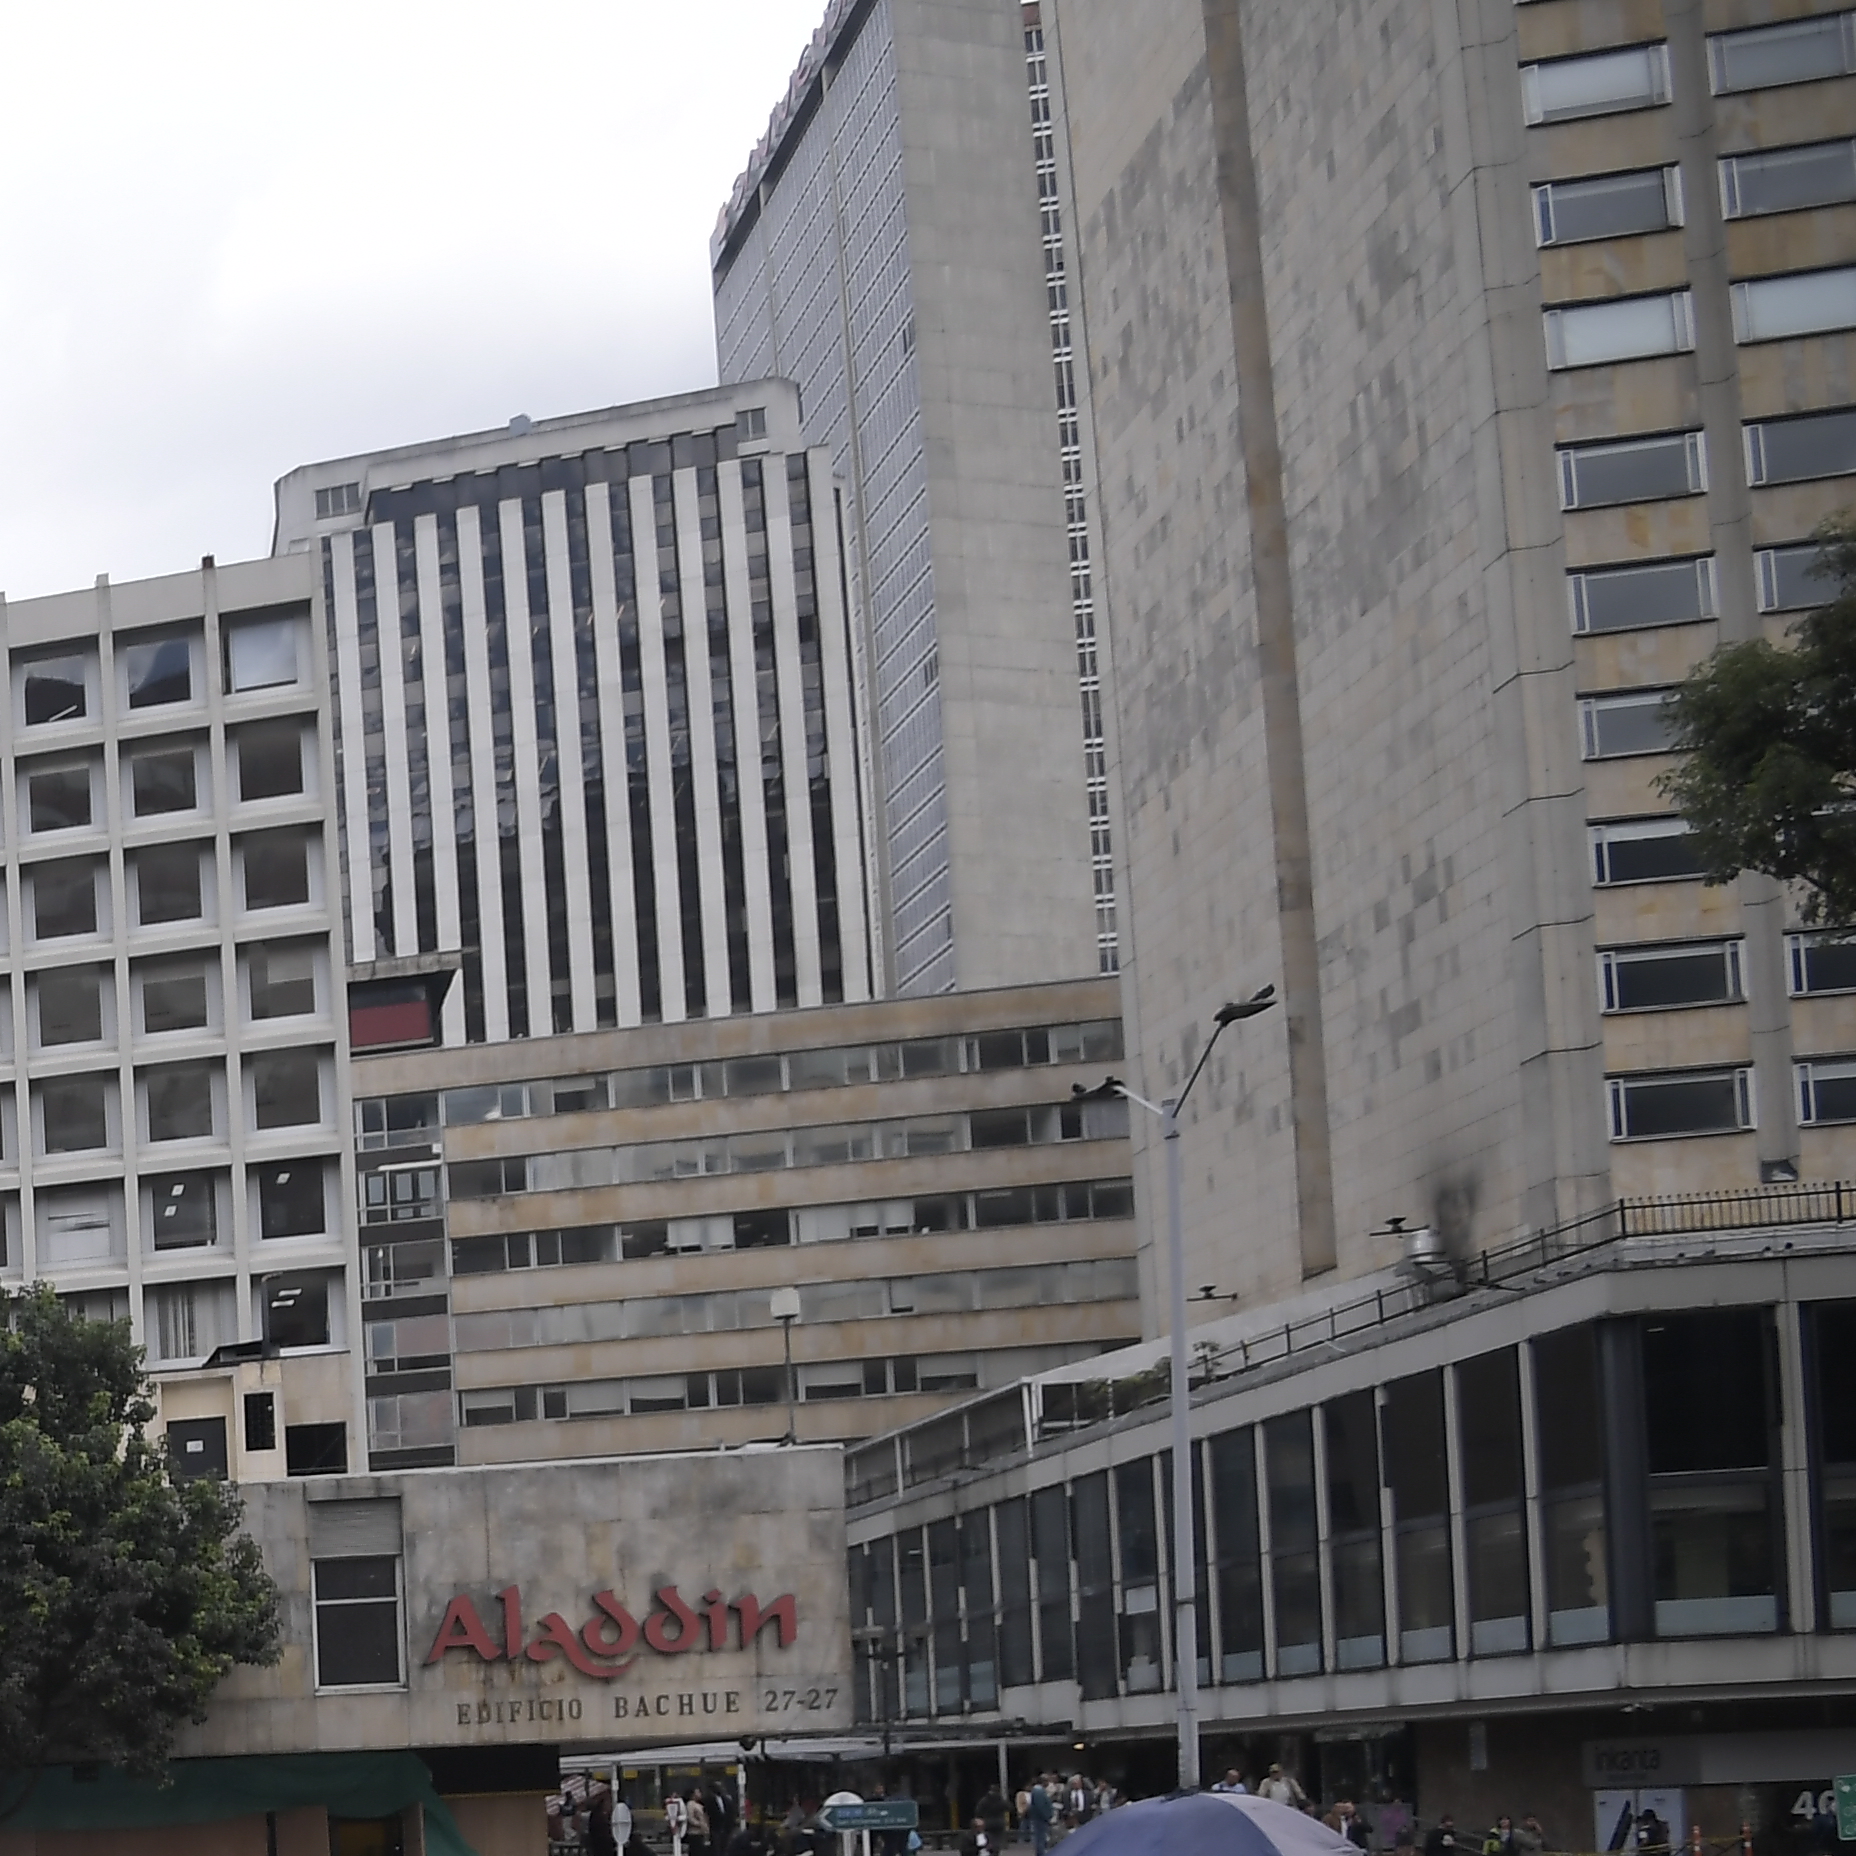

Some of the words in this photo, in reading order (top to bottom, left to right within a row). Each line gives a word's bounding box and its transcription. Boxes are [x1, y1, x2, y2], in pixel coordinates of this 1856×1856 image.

[423, 1584, 798, 1678] Aladdin
[456, 1698, 584, 1725] EDIFICIO
[614, 1691, 741, 1719] BACHUE
[764, 1687, 838, 1713] 27-27
